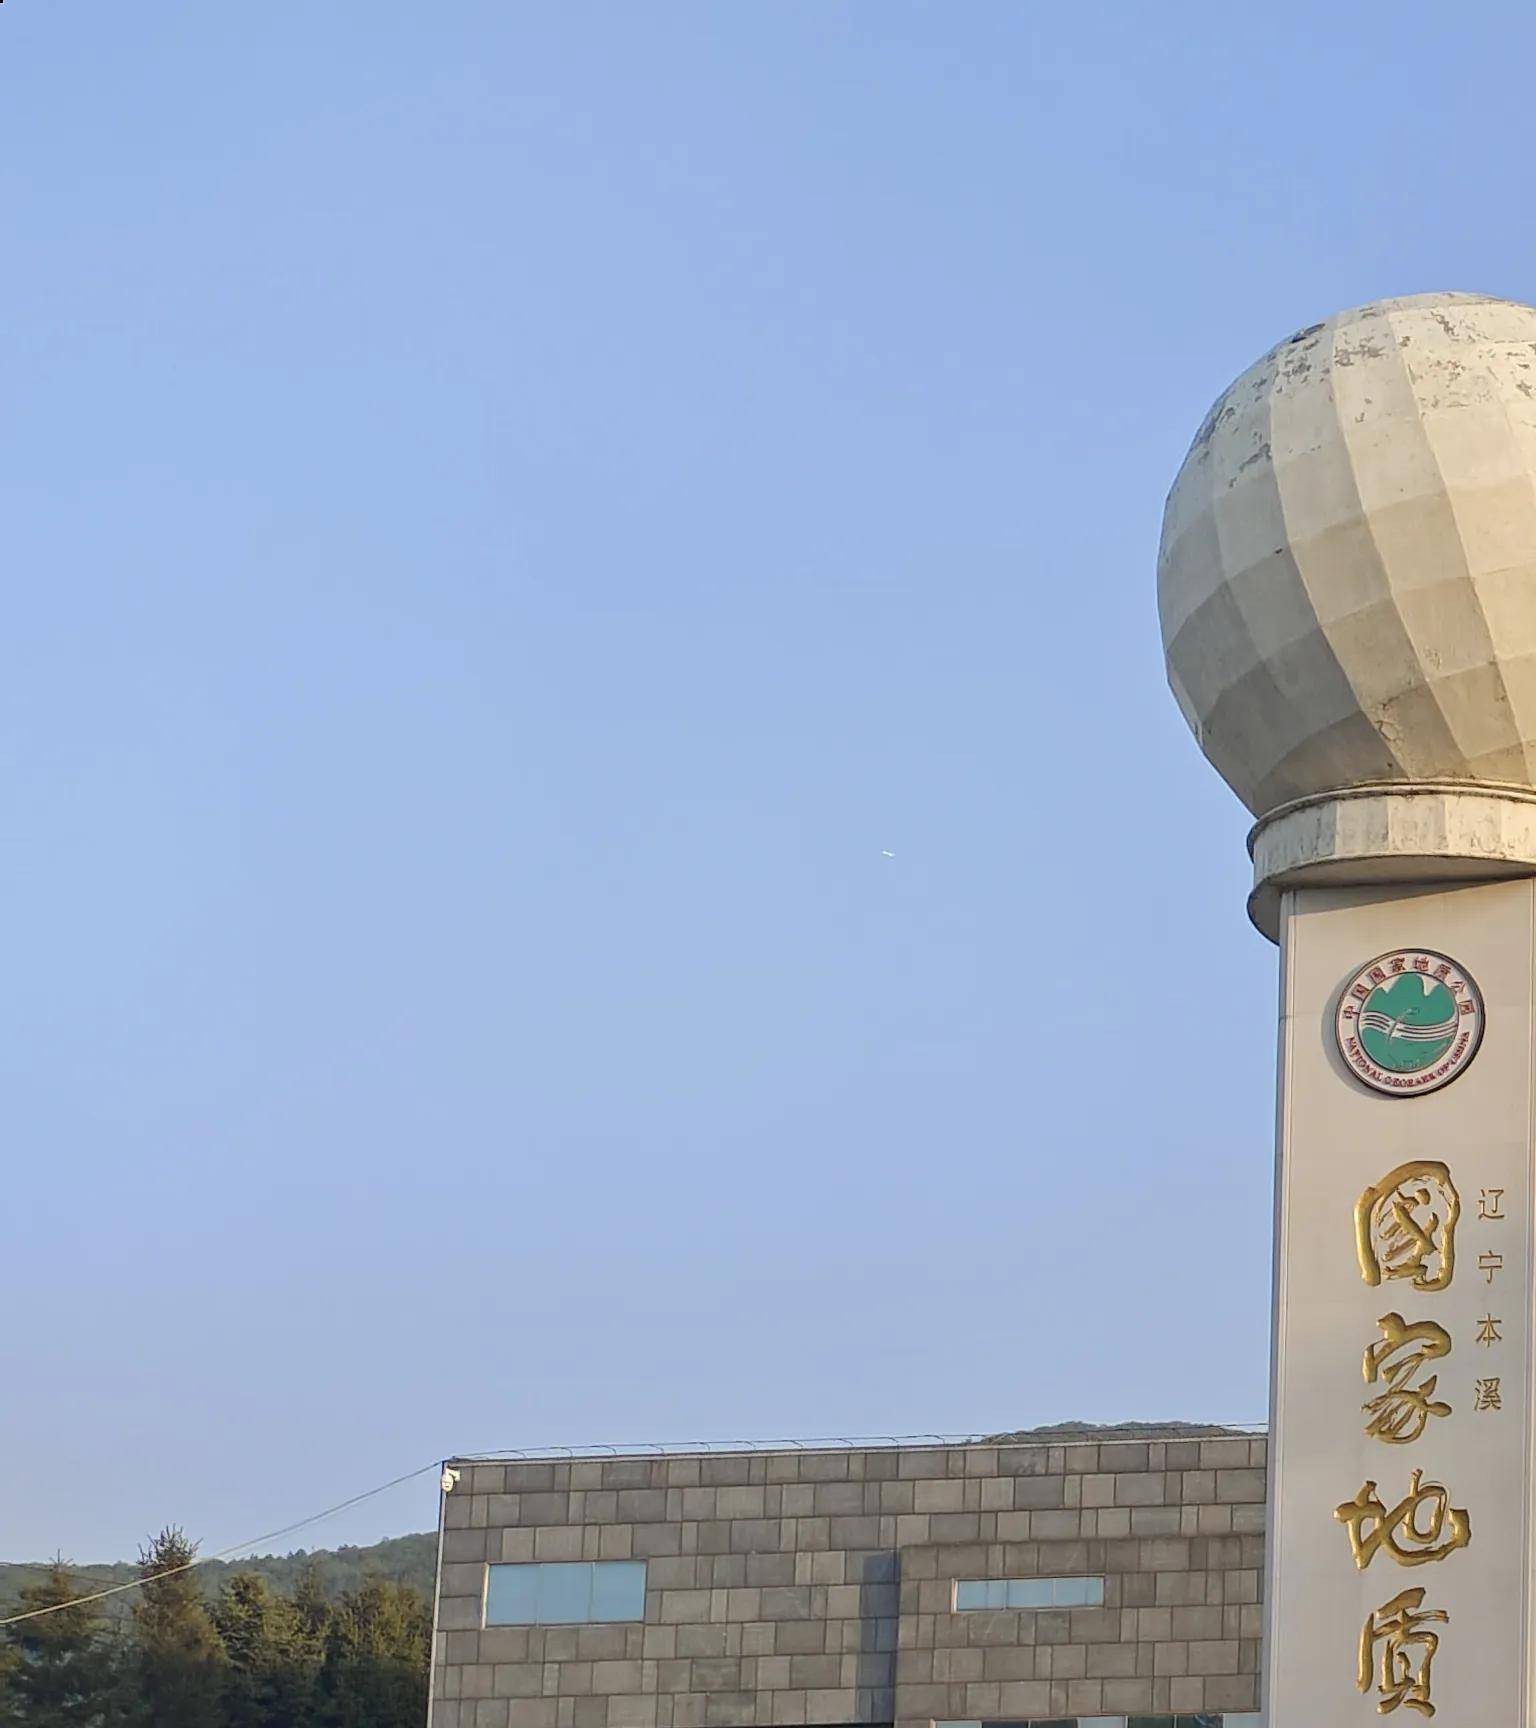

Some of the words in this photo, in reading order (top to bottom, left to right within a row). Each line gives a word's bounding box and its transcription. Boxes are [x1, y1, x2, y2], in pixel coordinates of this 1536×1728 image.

[1345, 1036, 1382, 1082] NATIONAL
[1473, 1188, 1507, 1412] 辽宁本溪
